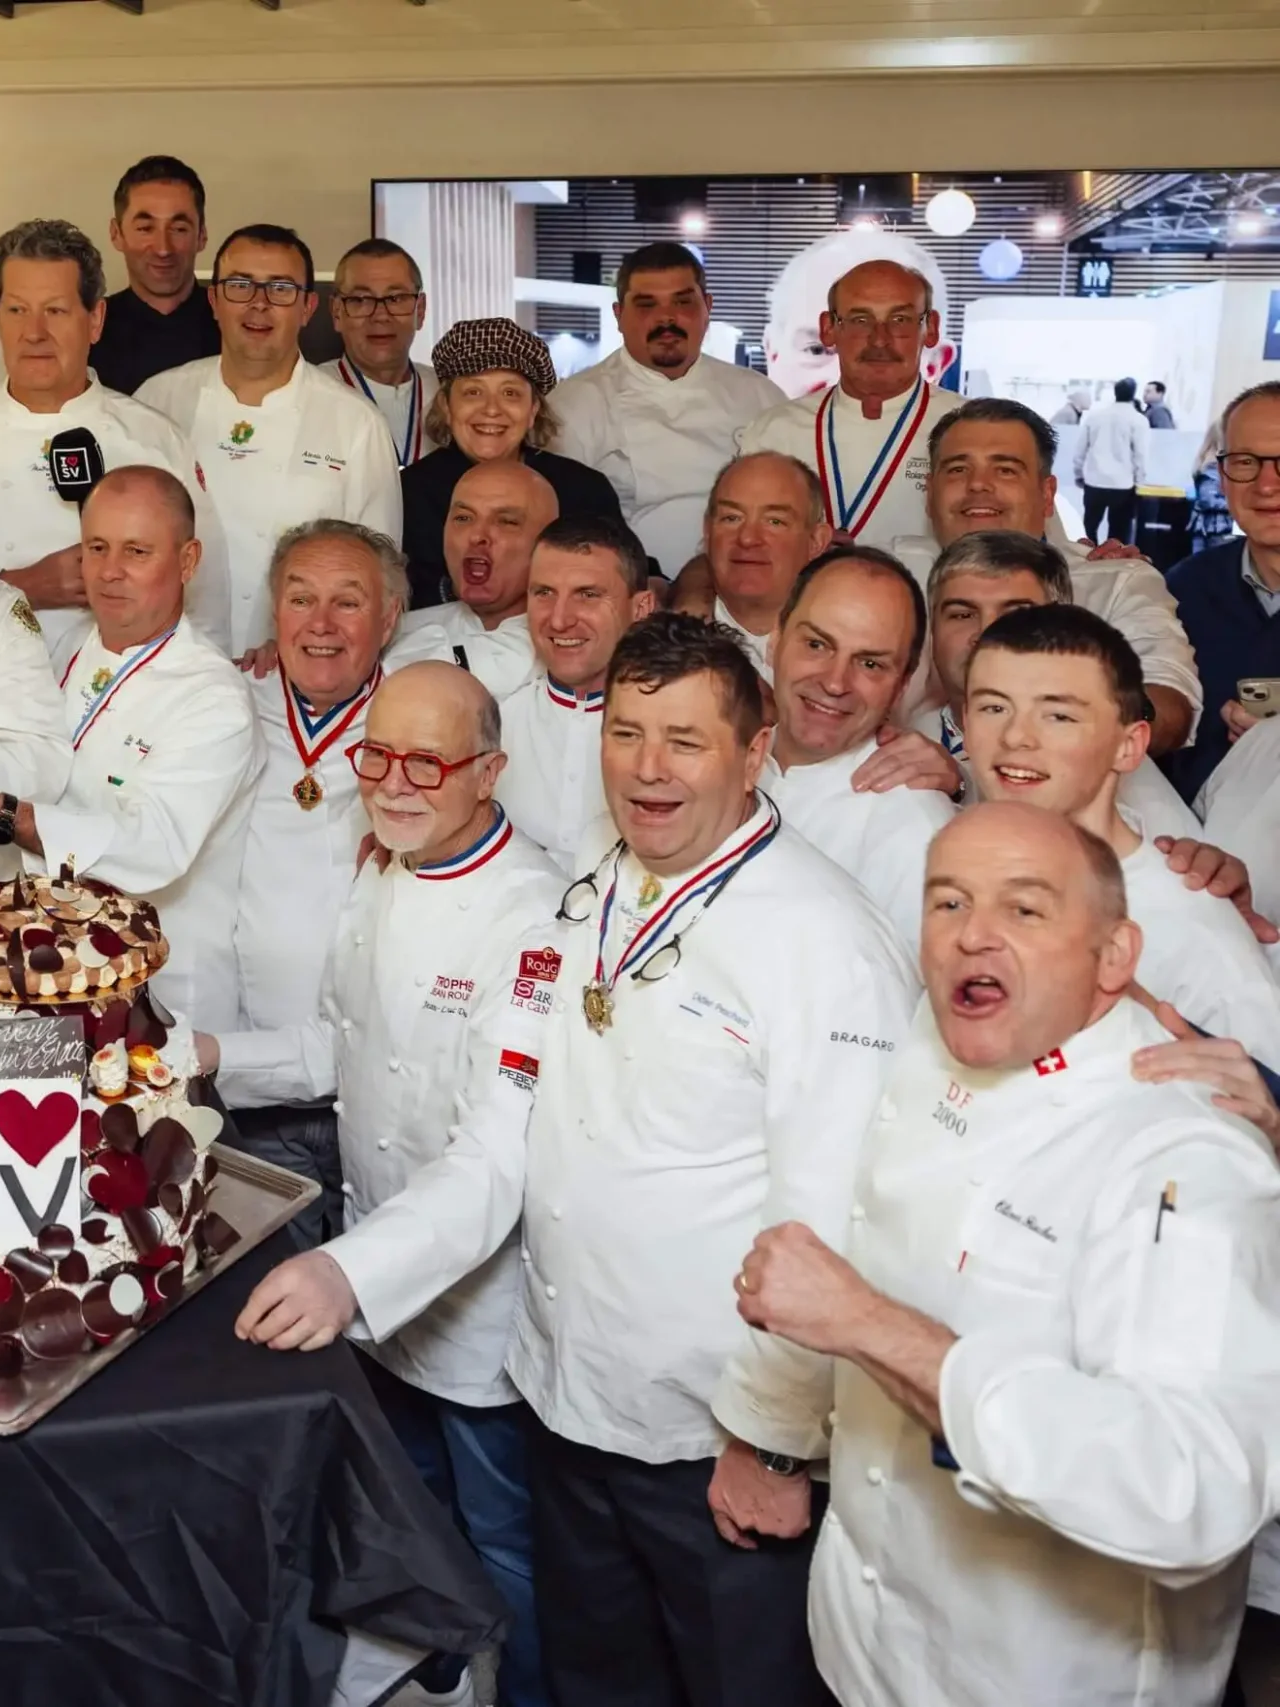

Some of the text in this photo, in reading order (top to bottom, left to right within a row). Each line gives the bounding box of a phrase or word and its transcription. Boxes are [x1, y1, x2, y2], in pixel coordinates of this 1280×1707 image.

[62, 466, 80, 479] SV
[829, 1031, 896, 1053] BRAGARD
[931, 1100, 968, 1138] 2000
